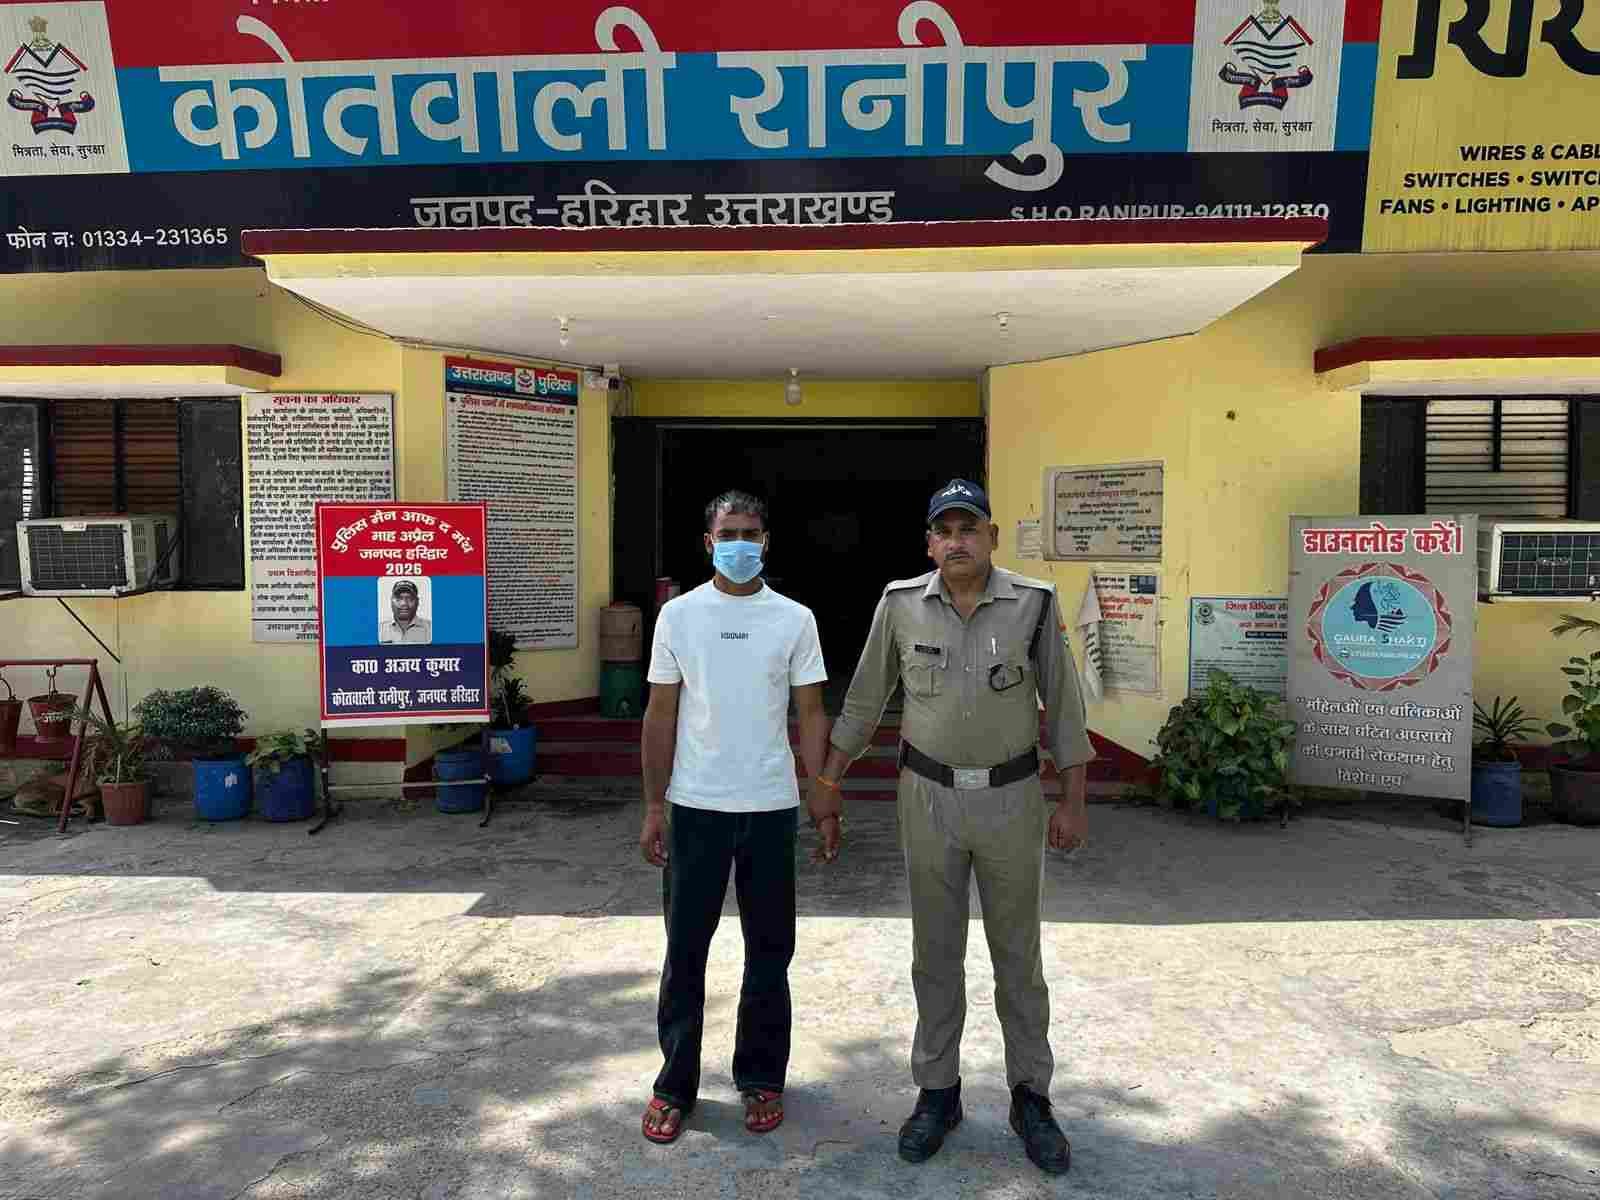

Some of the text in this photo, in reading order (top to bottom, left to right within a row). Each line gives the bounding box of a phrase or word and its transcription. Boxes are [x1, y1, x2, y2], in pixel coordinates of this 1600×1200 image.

[158, 1, 1147, 191] कोतवाली रानीपुर
[1281, 120, 1313, 137] सुरक्षा
[76, 144, 105, 160] सुरक्षा
[1460, 144, 1526, 161] WIRES
[1531, 145, 1545, 160] &
[1403, 170, 1600, 188] SWITCHES SWITC
[704, 191, 896, 226] उत्तराखण्ड
[1380, 198, 1435, 215] FANS
[1455, 197, 1551, 213] LIGHTING
[6, 225, 47, 249] फोन
[81, 228, 228, 248] 01334-231365
[537, 372, 572, 394] पुलिस
[330, 517, 369, 553] पुलिस
[1301, 521, 1408, 554] डाउनलोड
[358, 544, 449, 560] जनपद हरिद्वार
[385, 563, 422, 575] 2026
[384, 658, 421, 673] अजय
[424, 657, 461, 678] कुमार
[331, 687, 376, 706] कोतवाली
[416, 688, 447, 704] जनपद
